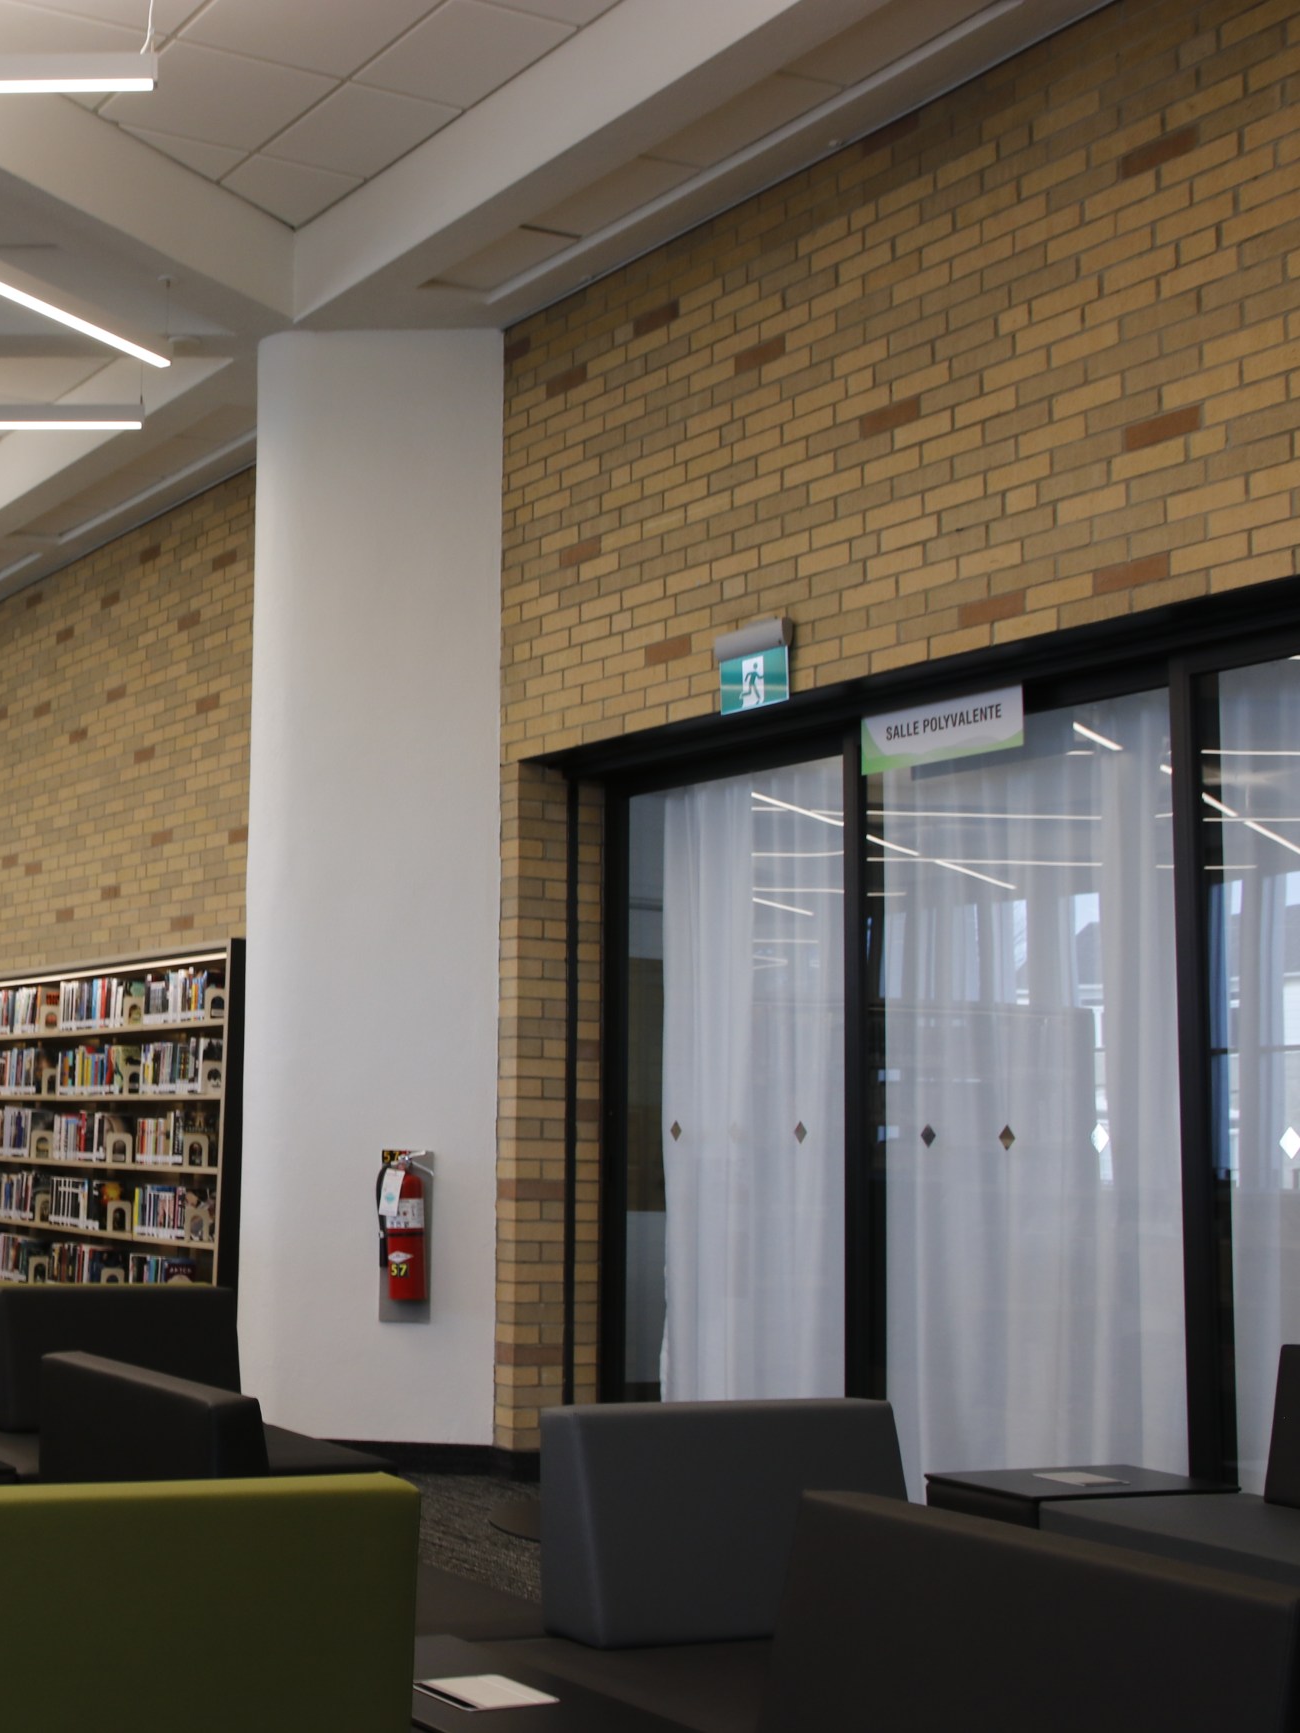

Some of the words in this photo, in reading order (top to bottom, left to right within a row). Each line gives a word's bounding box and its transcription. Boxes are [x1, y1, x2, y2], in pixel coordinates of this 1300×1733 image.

[886, 720, 919, 741] SALLE
[923, 703, 1002, 733] POLYVALENTE
[383, 1151, 400, 1164] 57
[391, 1264, 407, 1277] 57
